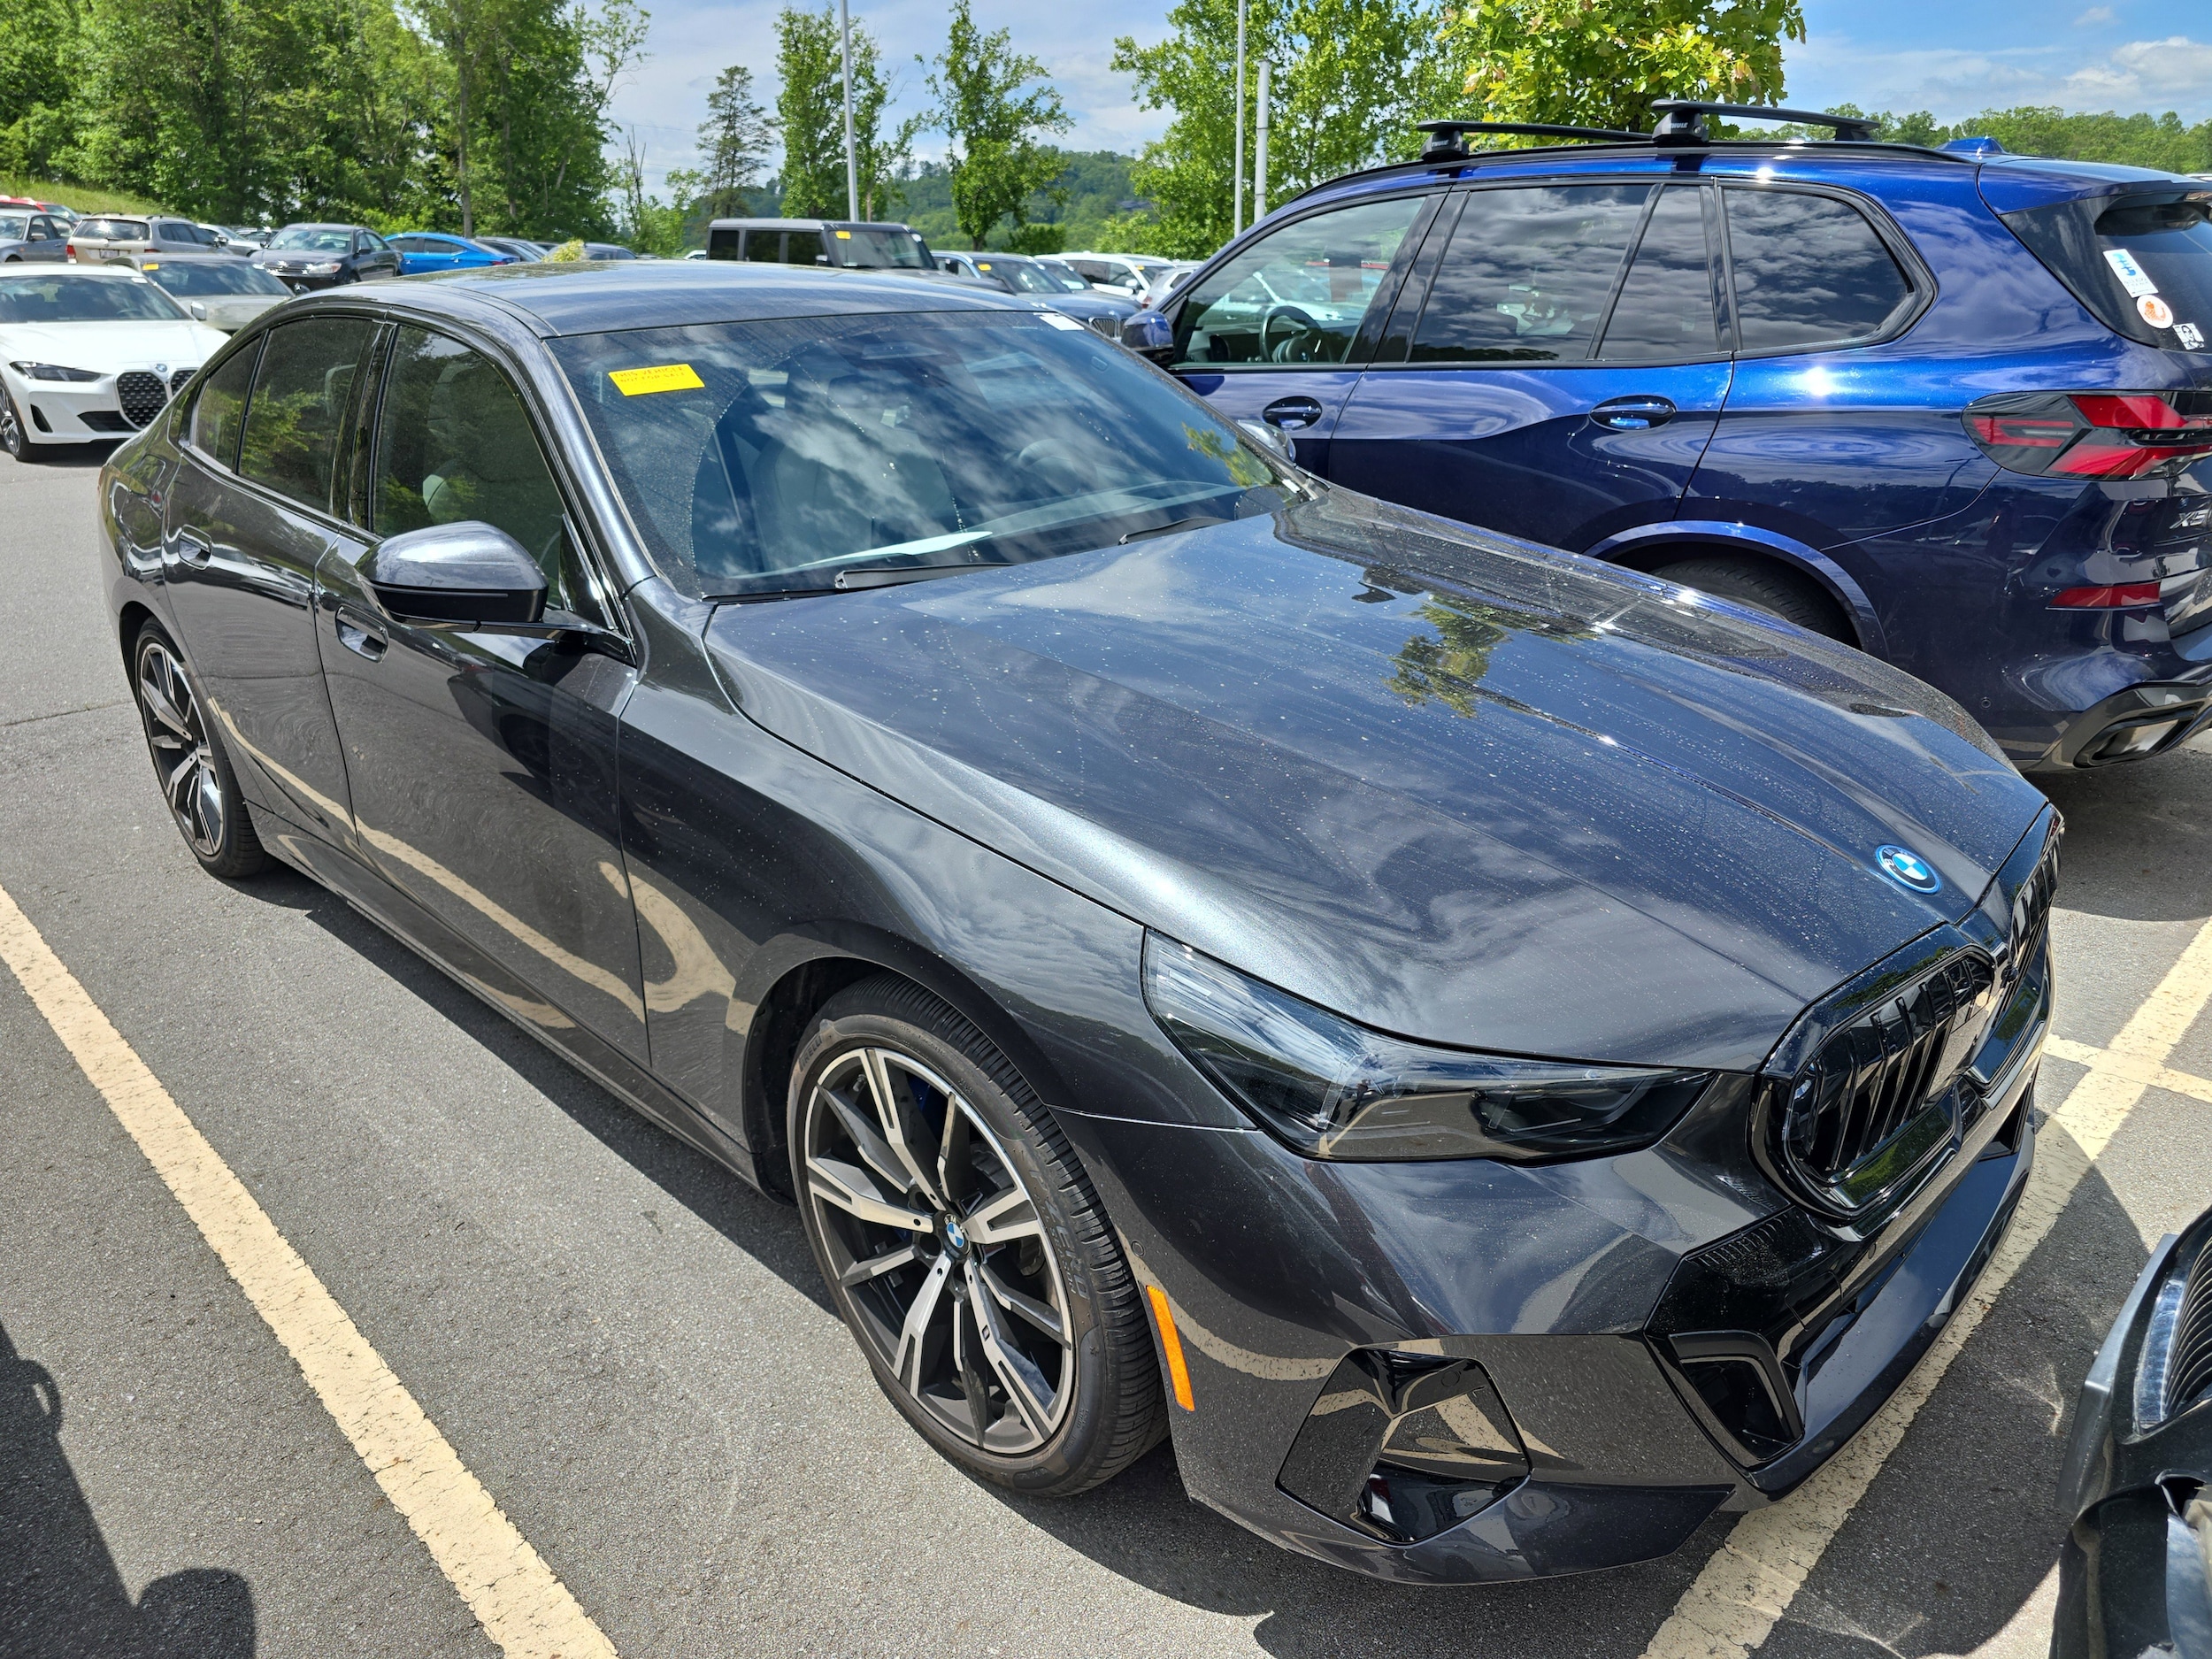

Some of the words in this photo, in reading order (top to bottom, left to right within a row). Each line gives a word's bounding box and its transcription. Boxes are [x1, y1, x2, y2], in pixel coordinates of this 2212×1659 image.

[642, 366, 683, 375] VEHICLE
[798, 1035, 822, 1072] PIRELLI
[1045, 1200, 1090, 1301] ZERO
[1049, 1226, 1077, 1295] SEASON
